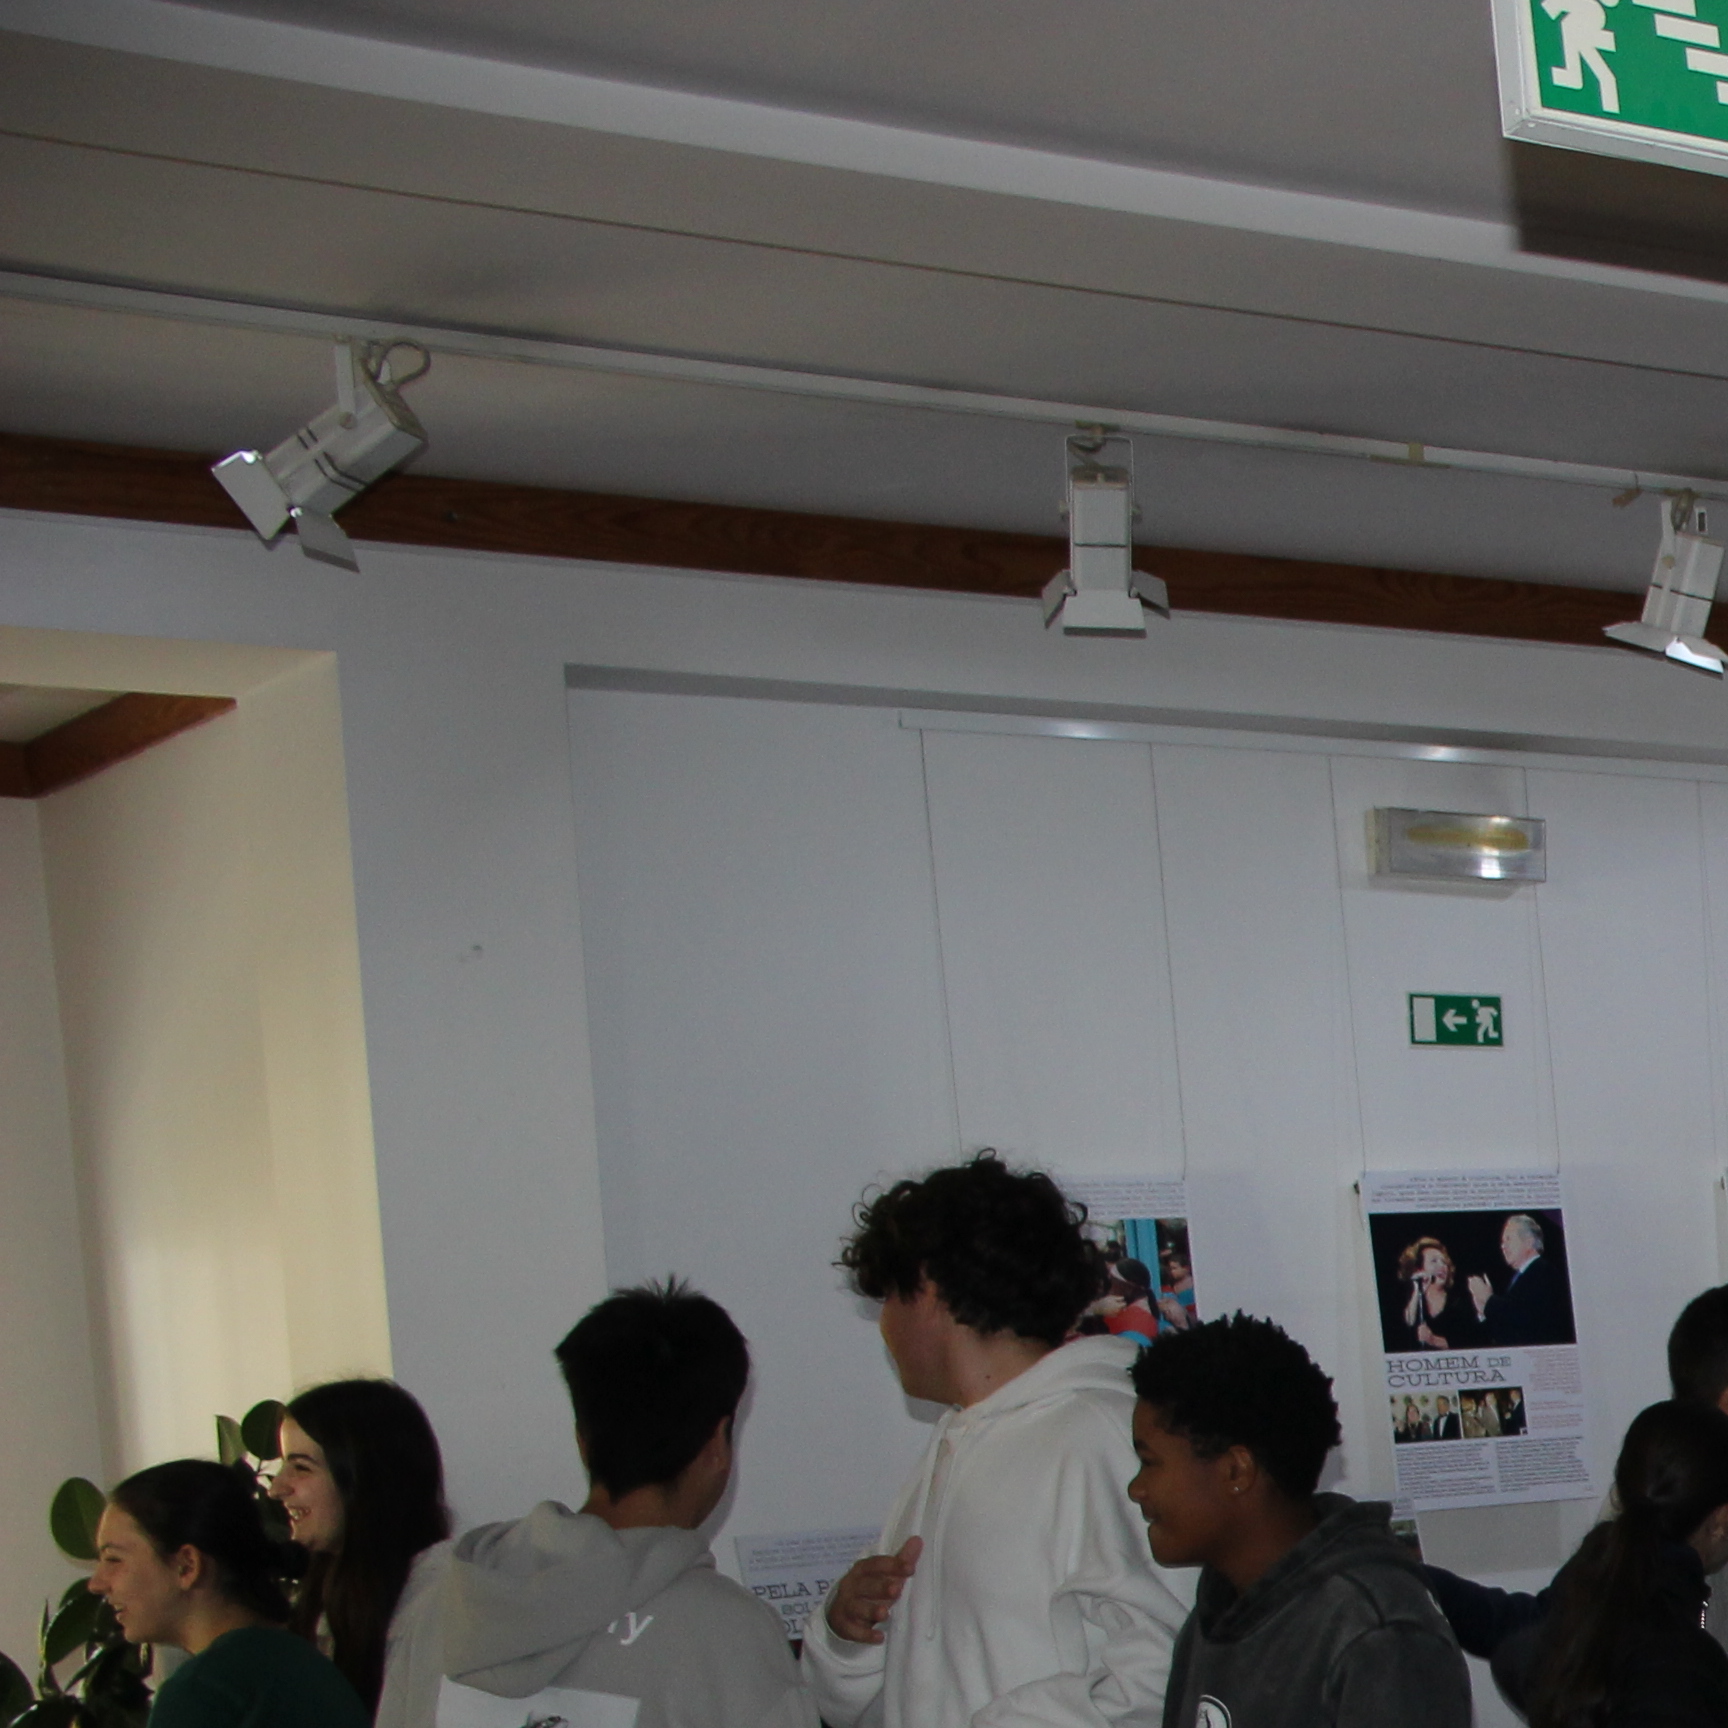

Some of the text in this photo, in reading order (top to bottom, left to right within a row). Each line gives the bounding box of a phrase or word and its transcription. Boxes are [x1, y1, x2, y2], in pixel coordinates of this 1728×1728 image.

[1386, 1356, 1512, 1374] HOMEM DE
[1387, 1369, 1506, 1388] CULTURA
[751, 1582, 812, 1600] PELA
